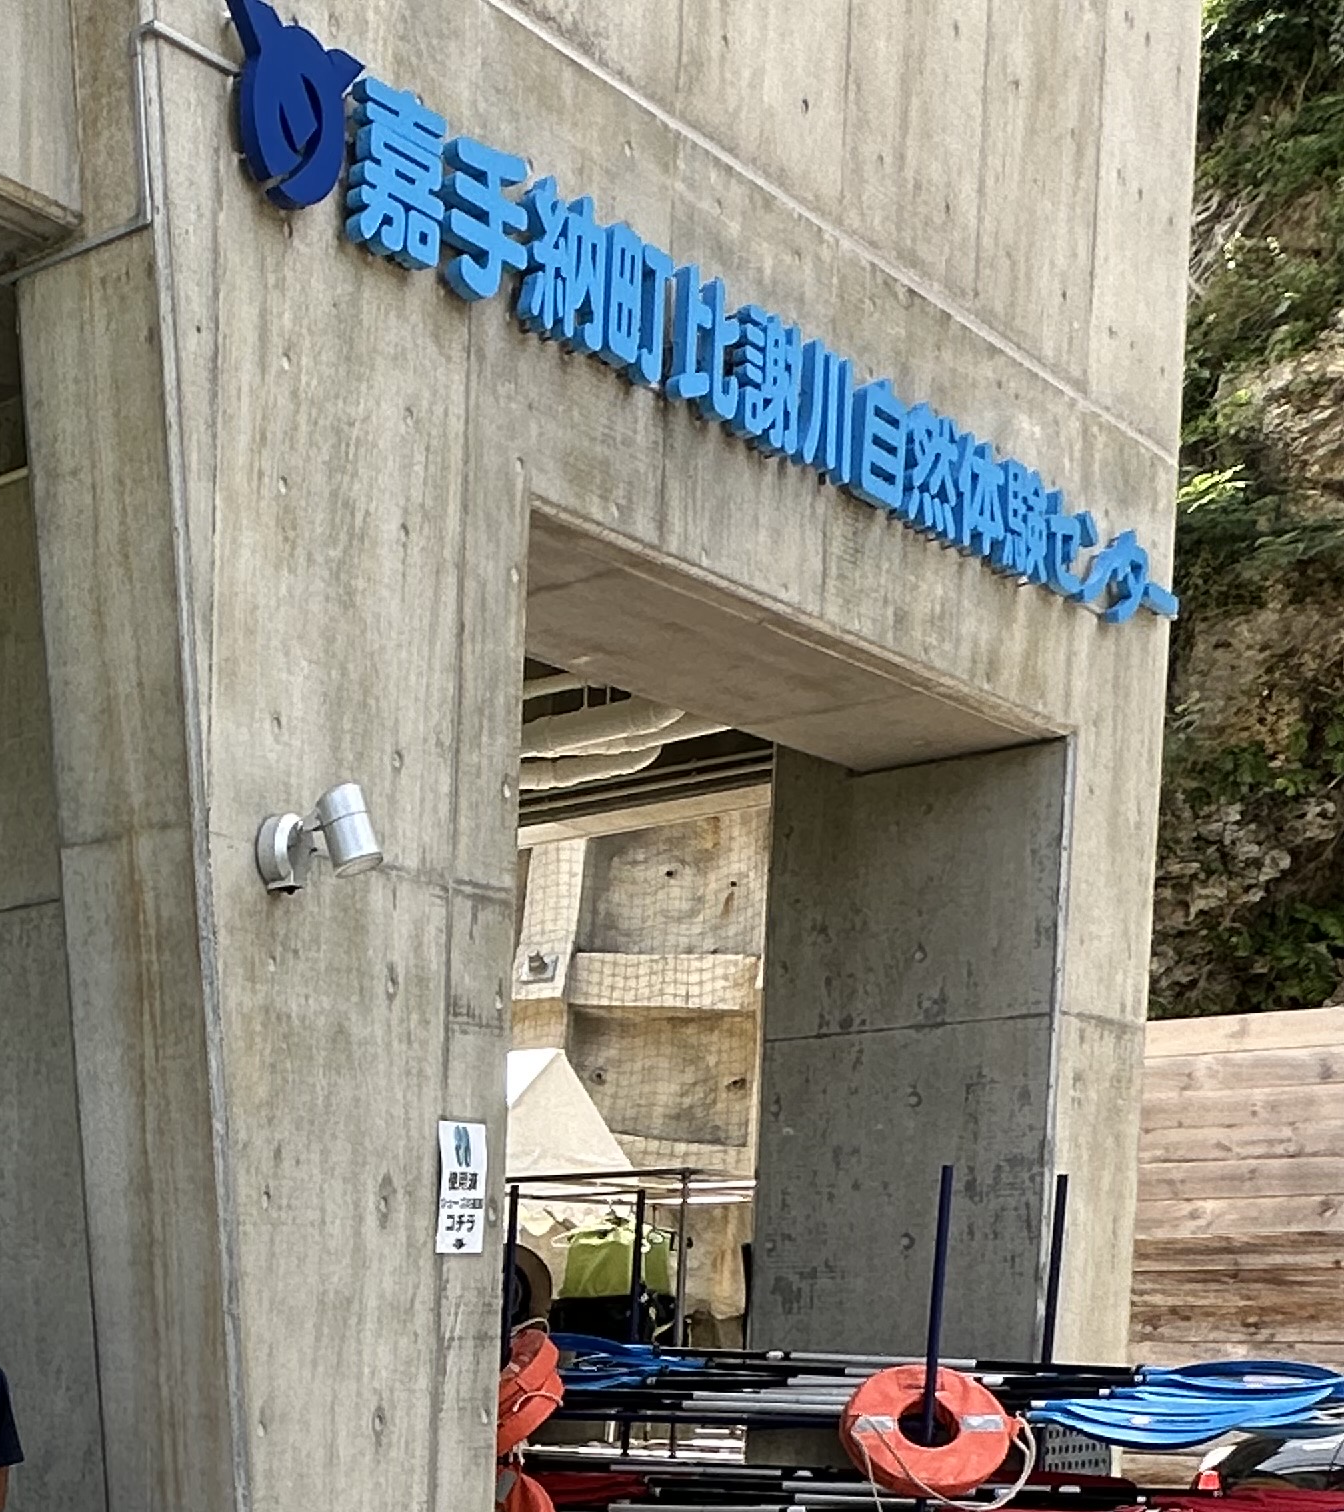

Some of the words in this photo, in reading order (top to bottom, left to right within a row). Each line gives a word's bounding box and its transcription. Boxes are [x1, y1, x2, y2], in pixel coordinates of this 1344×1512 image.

[346, 76, 1179, 624] 嘉手納町比謝川自然体験センター
[445, 1214, 476, 1233] コチラ
